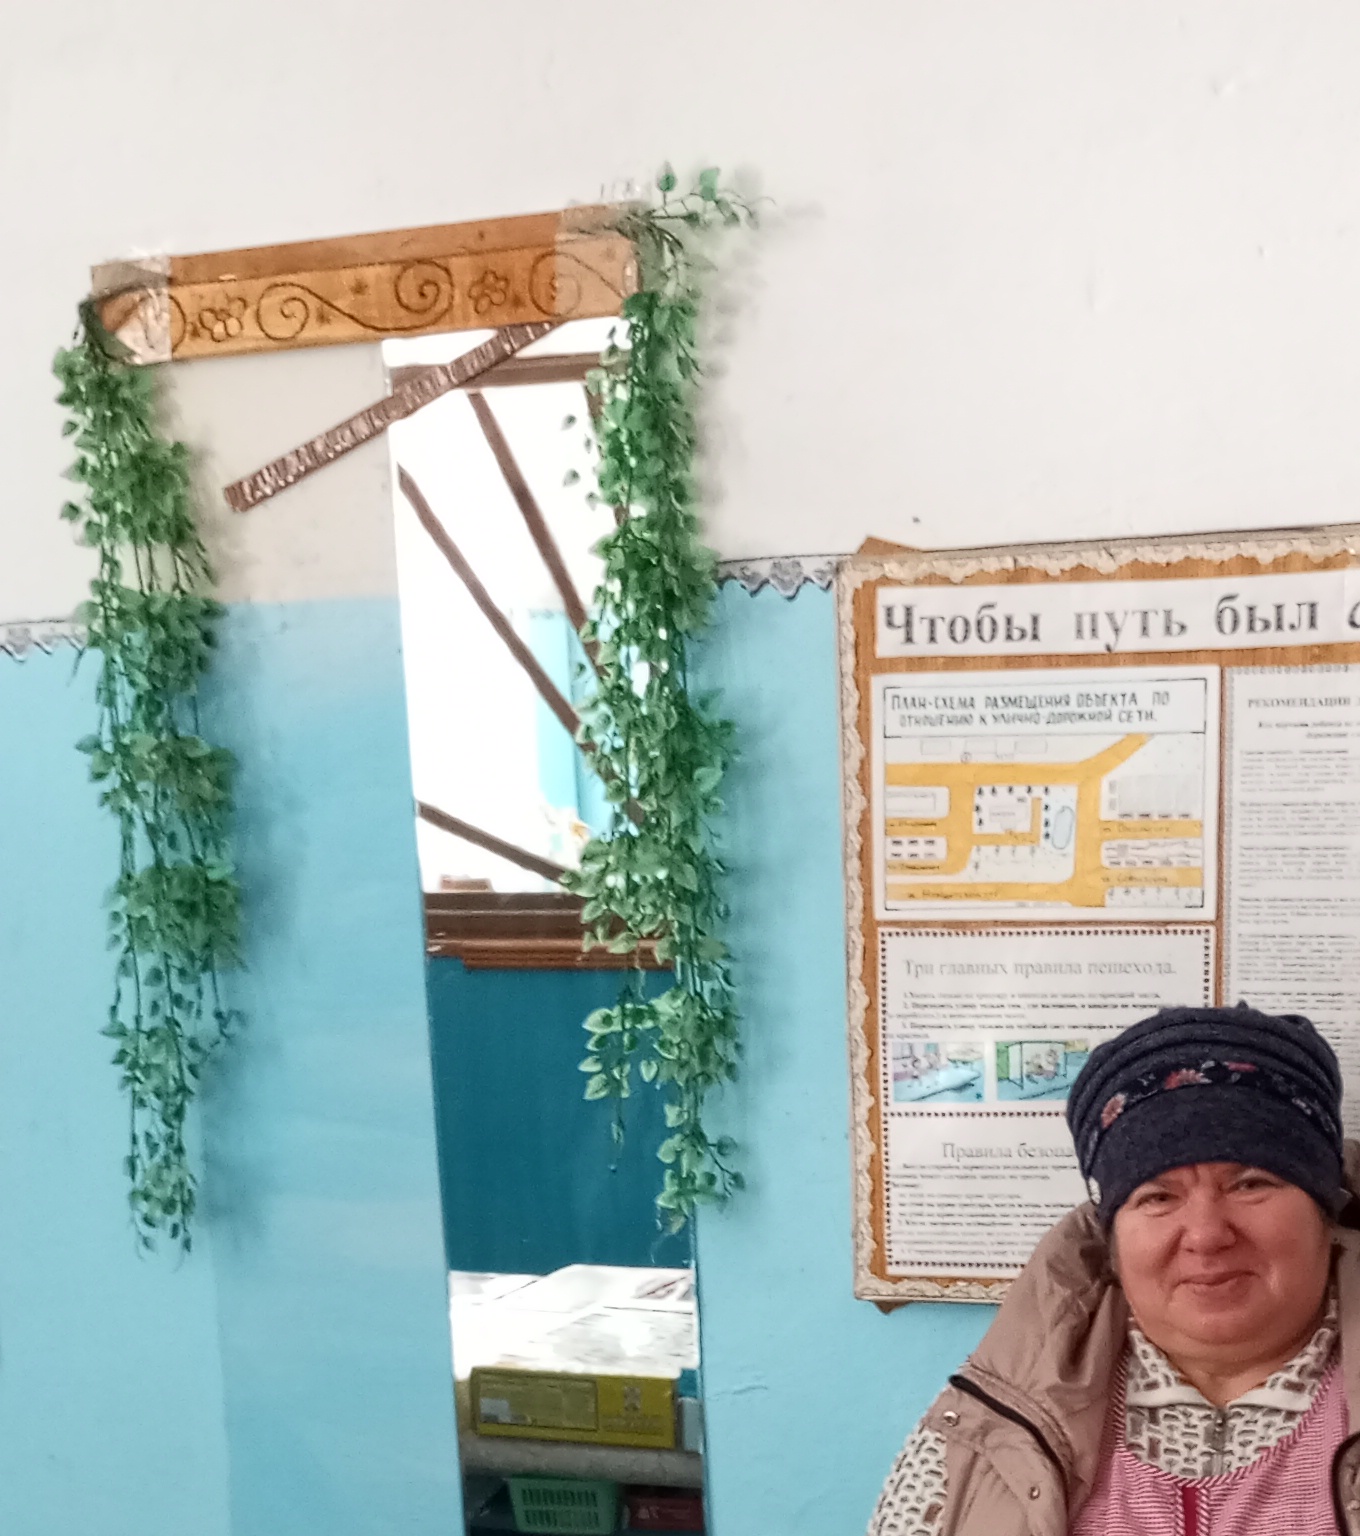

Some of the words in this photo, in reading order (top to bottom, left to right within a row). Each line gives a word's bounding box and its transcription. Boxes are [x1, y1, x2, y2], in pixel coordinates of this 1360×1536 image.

[883, 602, 1042, 647] Чтобы
[1074, 606, 1188, 653] путь
[1216, 593, 1318, 636] был
[1152, 691, 1170, 706] ПО
[903, 959, 936, 979] Три
[940, 961, 1008, 975] главных
[1014, 961, 1083, 978] правила
[942, 1143, 1012, 1163] Правила
